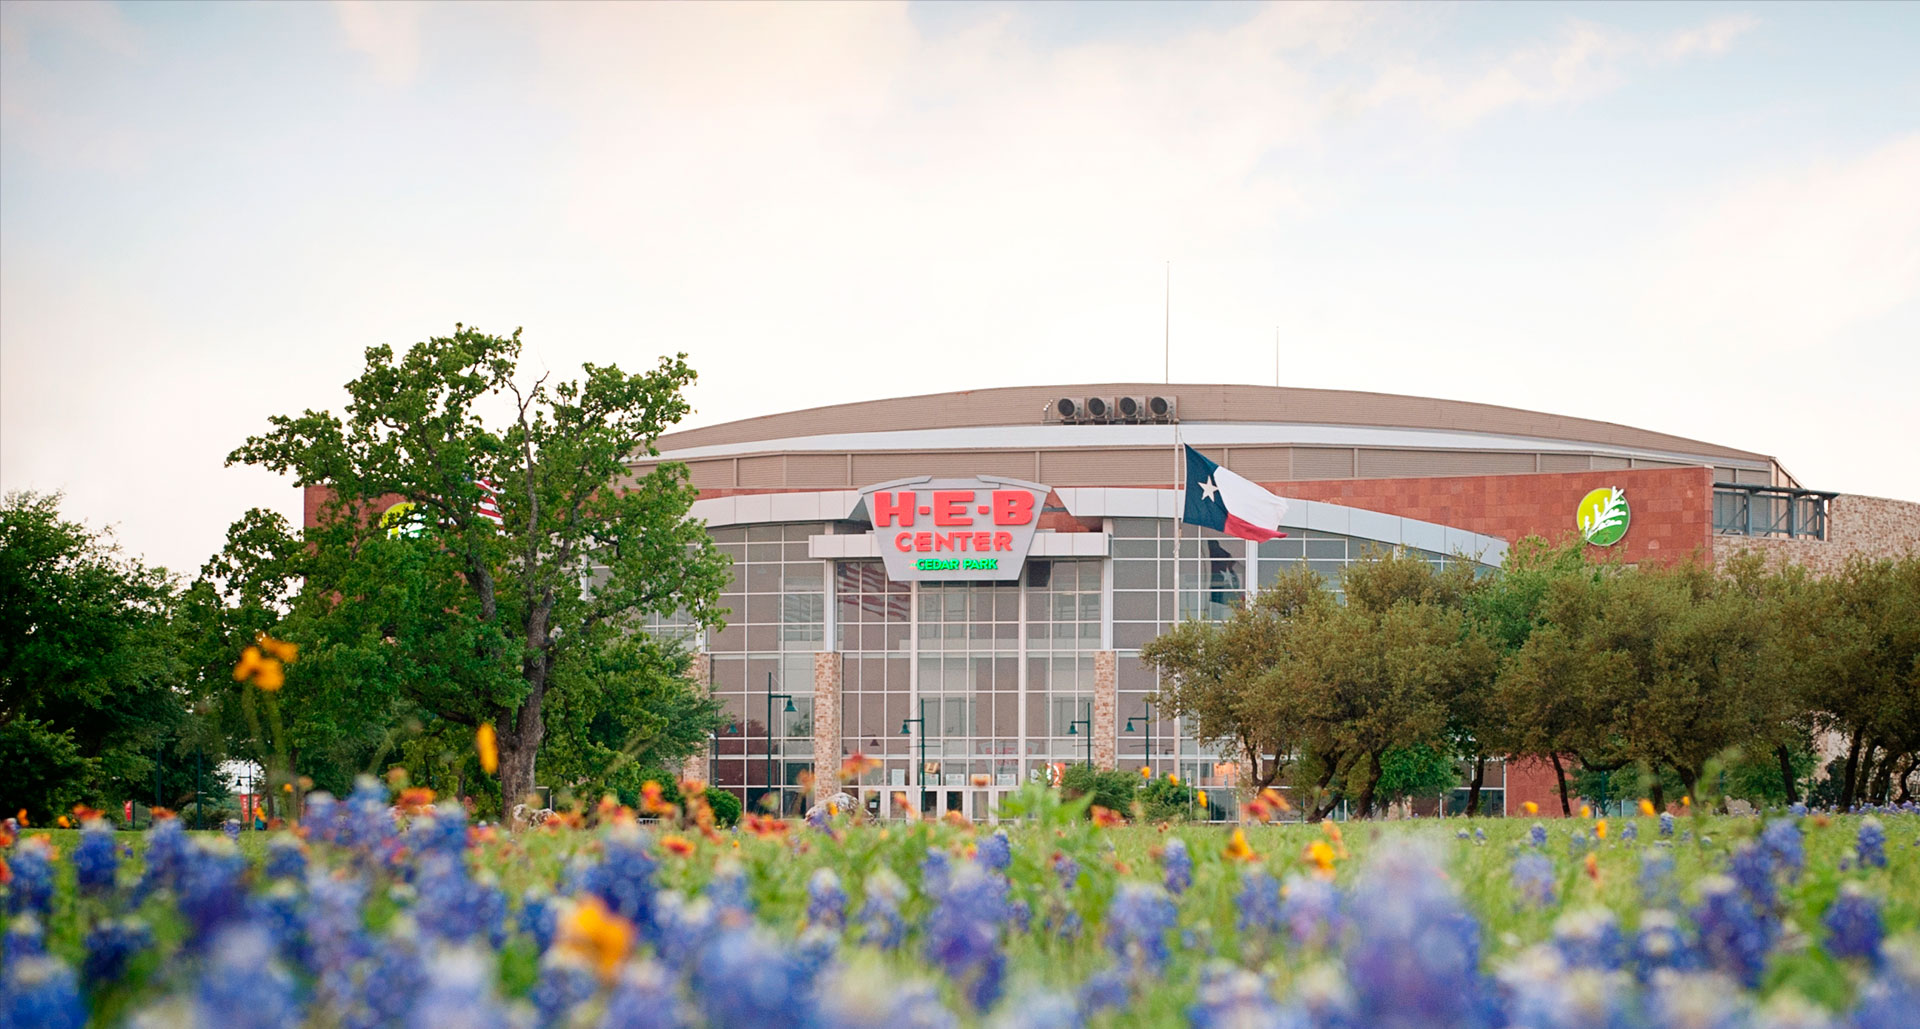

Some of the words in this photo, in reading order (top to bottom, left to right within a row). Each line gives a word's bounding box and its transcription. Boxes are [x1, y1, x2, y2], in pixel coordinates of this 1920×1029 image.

[895, 531, 1013, 552] CENTER
[915, 558, 960, 570] CEDAR
[962, 558, 998, 570] PARK
